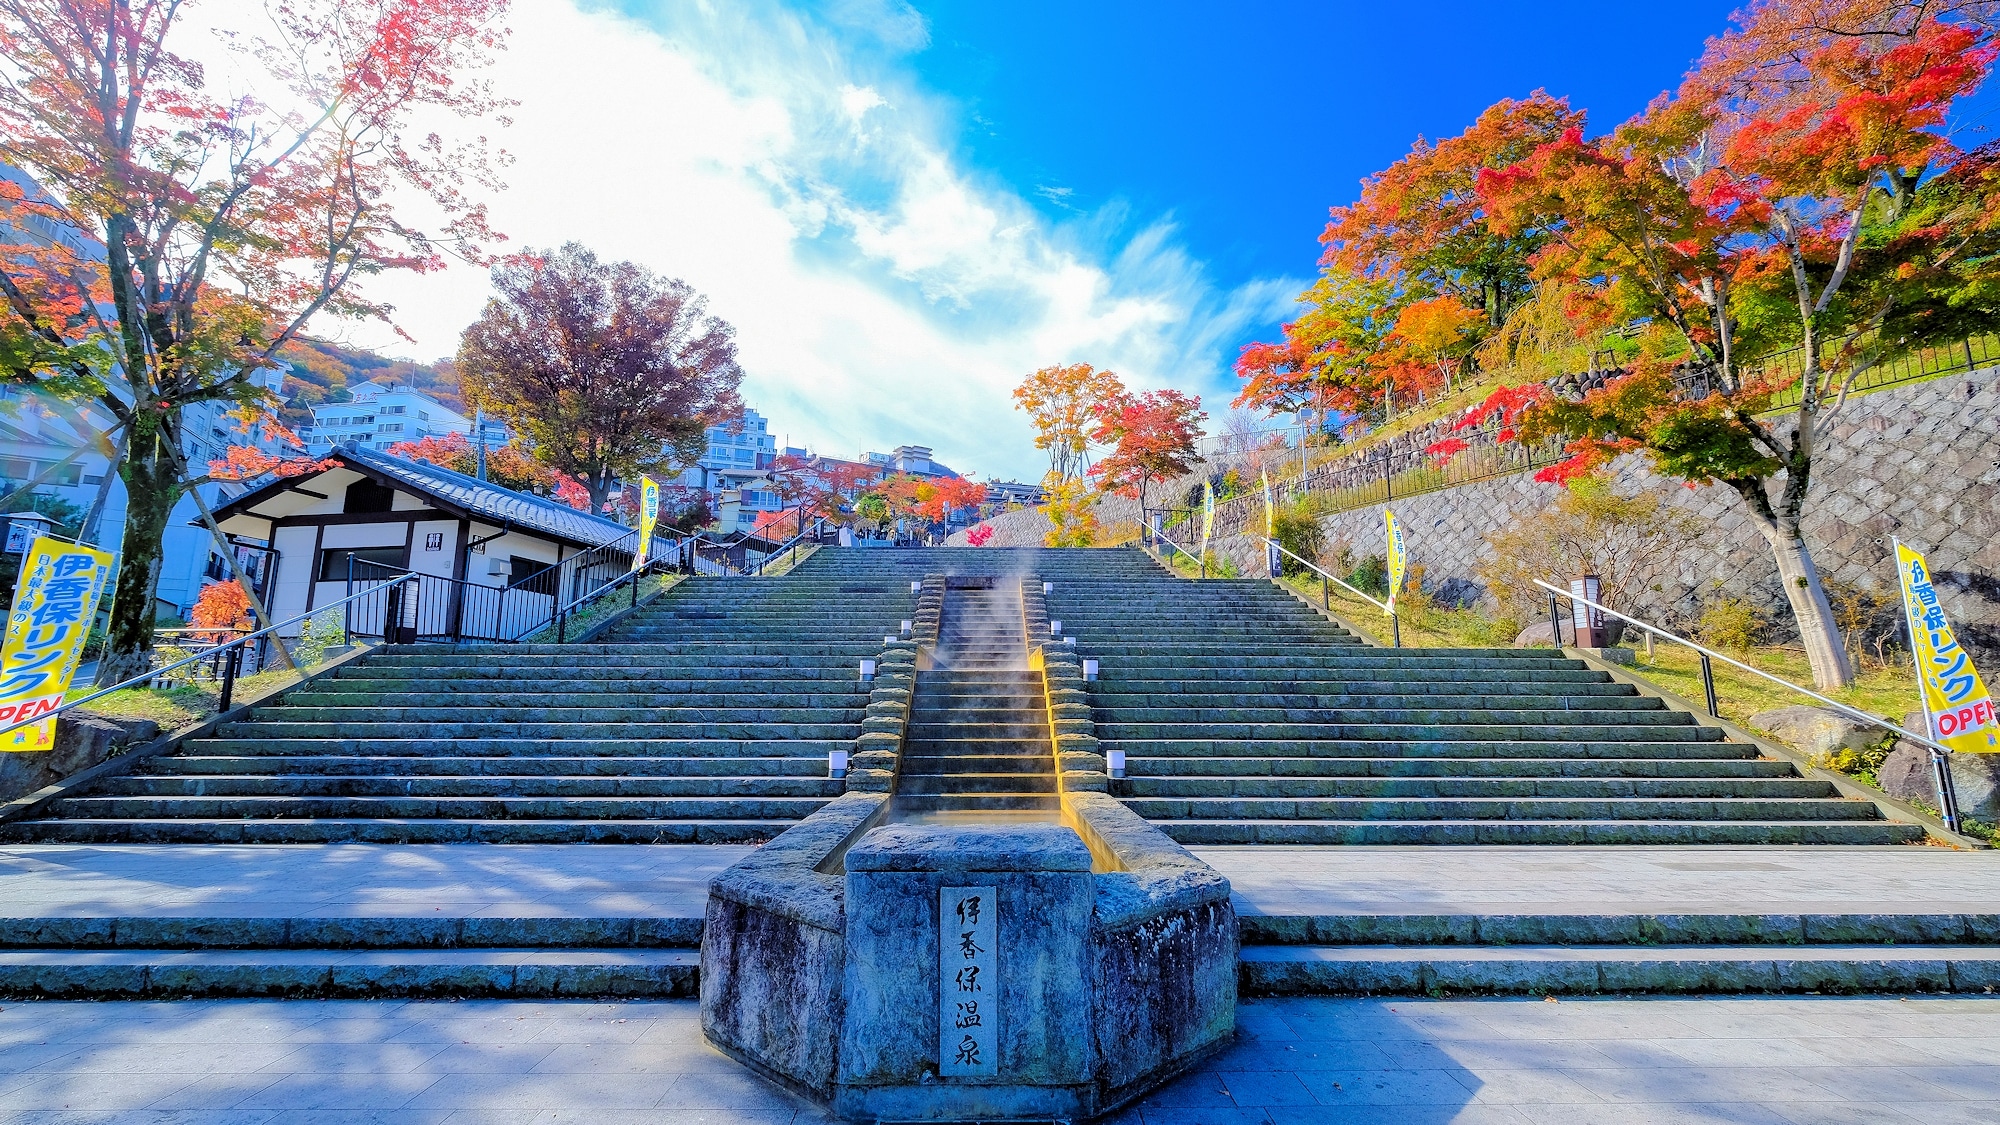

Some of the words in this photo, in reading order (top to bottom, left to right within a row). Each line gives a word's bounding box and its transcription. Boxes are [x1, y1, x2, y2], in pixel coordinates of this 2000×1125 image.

[954, 895, 985, 1066] 伊香保温泉
